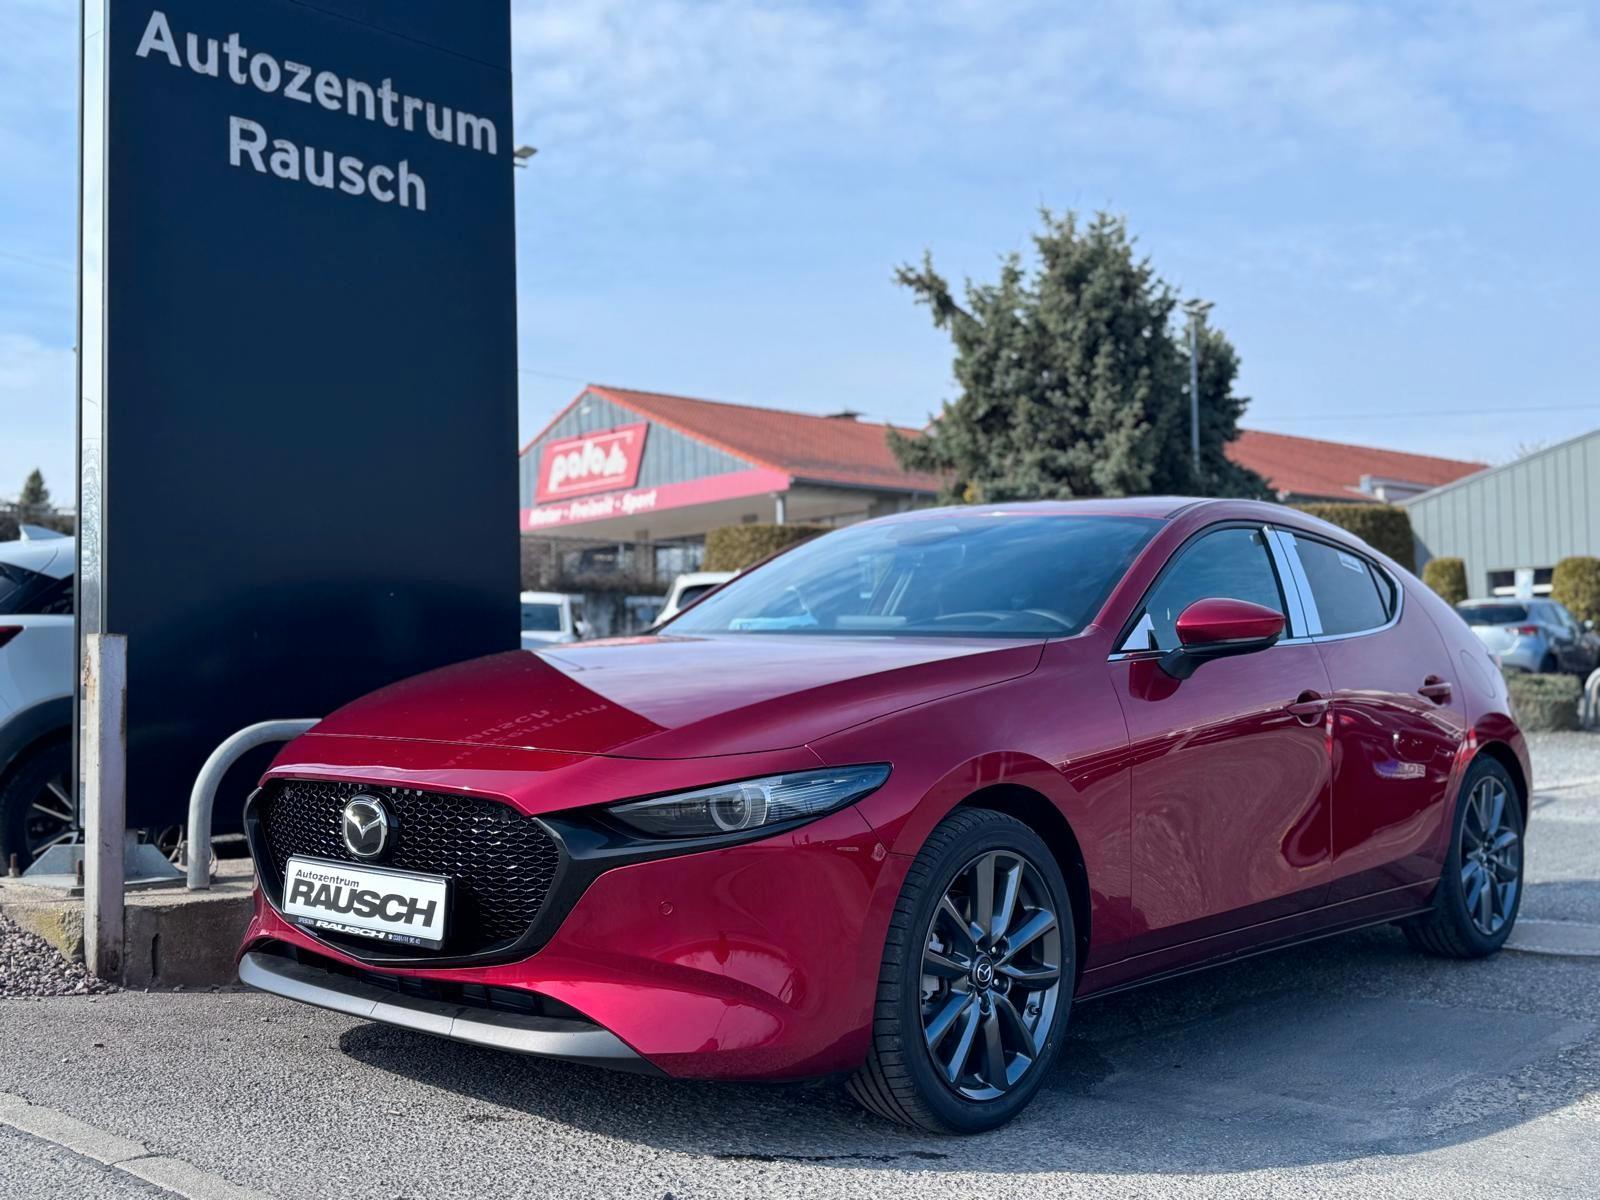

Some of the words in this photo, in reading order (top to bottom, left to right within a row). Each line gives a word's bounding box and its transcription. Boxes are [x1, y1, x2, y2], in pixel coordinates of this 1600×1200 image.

[135, 10, 498, 155] Autozentrum
[229, 115, 426, 211] Rausch
[548, 440, 606, 492] polo
[289, 878, 438, 928] RAUSCH
[296, 869, 360, 888] Autozentrum
[316, 920, 386, 939] RAUSCH
